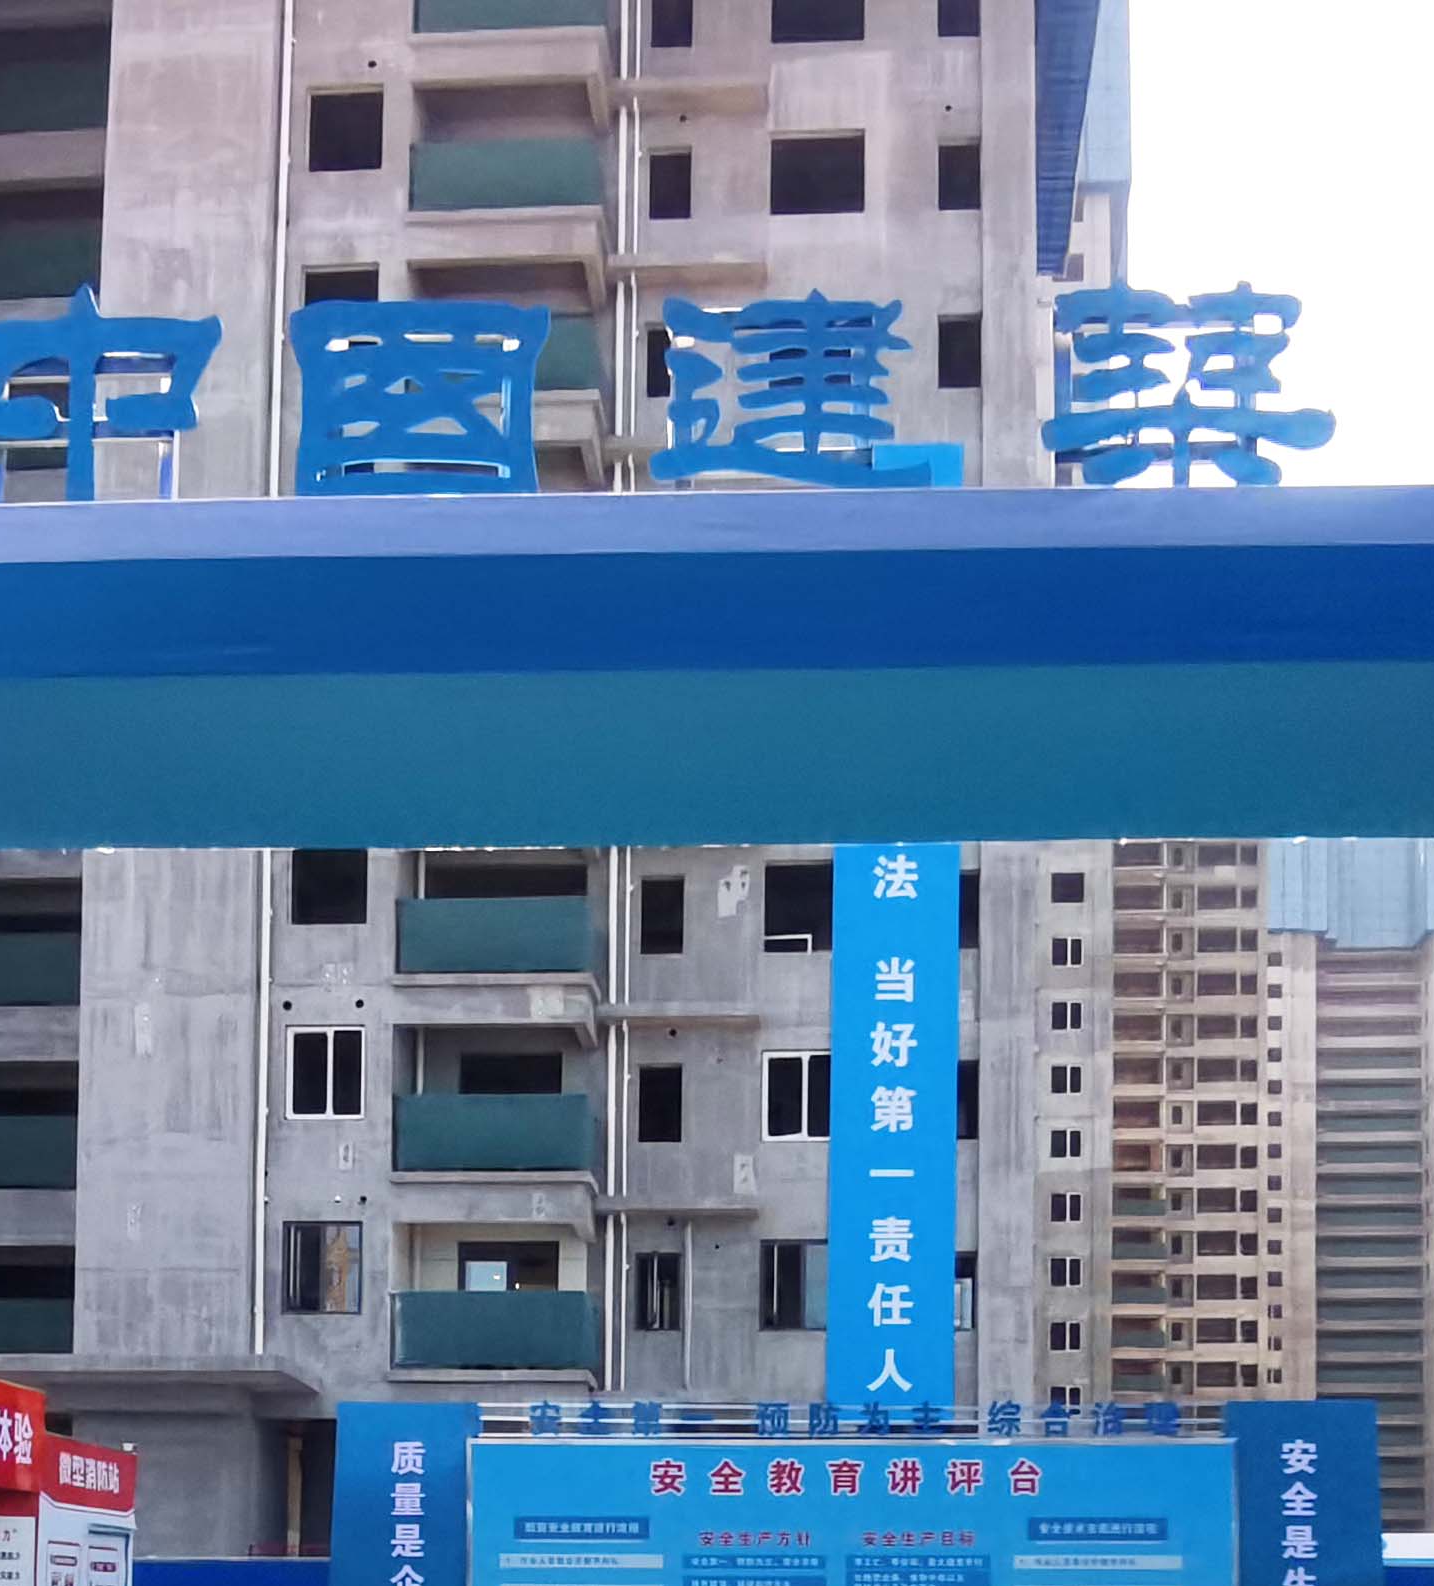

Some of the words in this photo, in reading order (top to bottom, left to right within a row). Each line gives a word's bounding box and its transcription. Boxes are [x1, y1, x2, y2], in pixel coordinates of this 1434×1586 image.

[873, 854, 919, 900] 法
[866, 957, 918, 1393] 当好第一责任人
[58, 1451, 120, 1495] 微型消防站
[651, 1458, 1042, 1497] 安全教育讲评台
[698, 1531, 812, 1547] 安全生产方针
[862, 1531, 977, 1547] 安全生产目标
